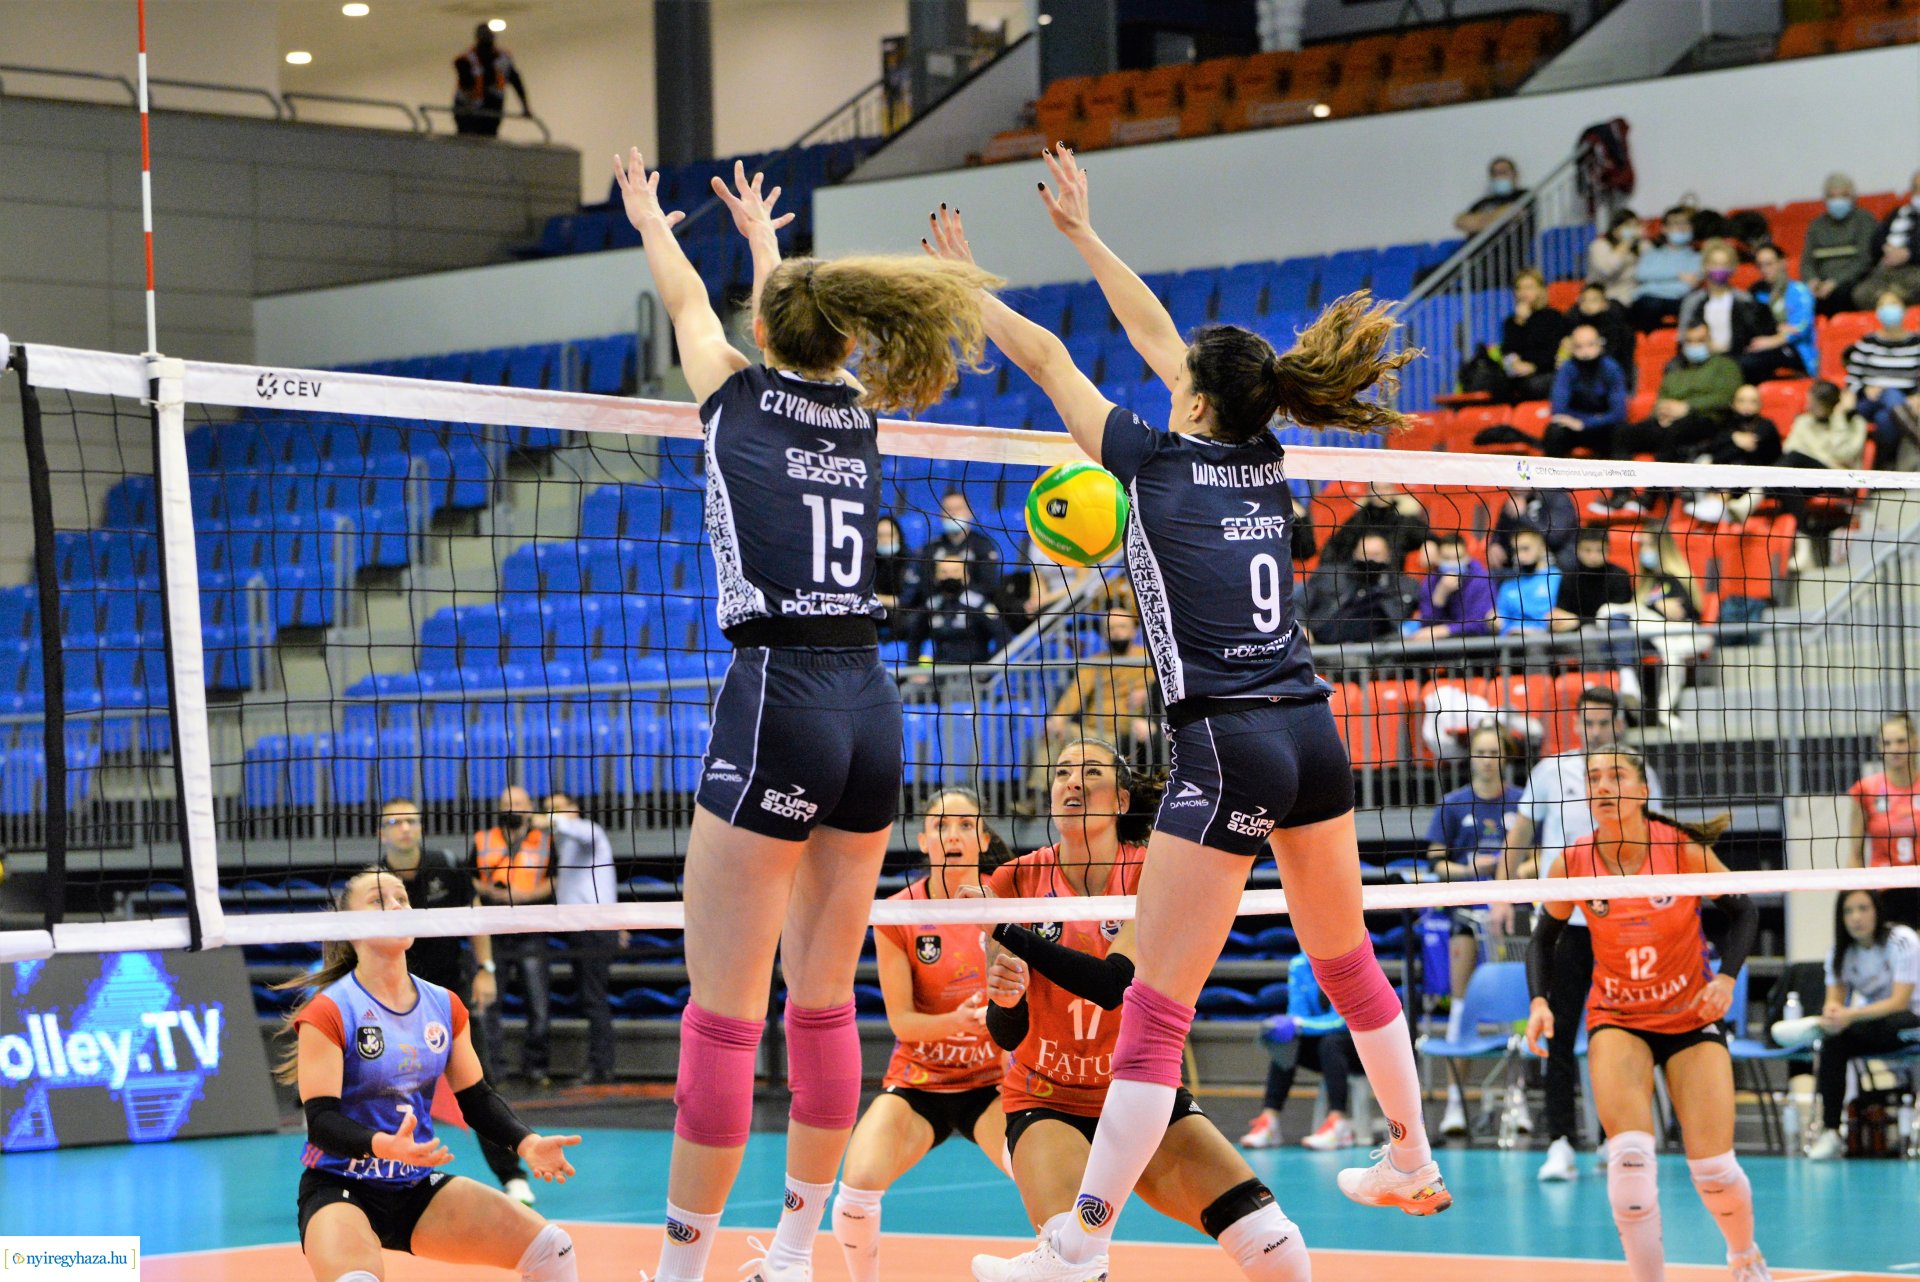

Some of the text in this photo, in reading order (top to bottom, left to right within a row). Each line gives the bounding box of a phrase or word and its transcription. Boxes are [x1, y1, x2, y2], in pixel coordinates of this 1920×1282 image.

[284, 380, 322, 397] CEV
[803, 494, 864, 588] 15
[781, 600, 850, 616] POLICE
[1250, 553, 1280, 633] 9
[1170, 799, 1209, 809] DAMONS
[1625, 946, 1658, 981] 12
[1068, 999, 1103, 1041] 17
[0, 1008, 220, 1090] olley.TV
